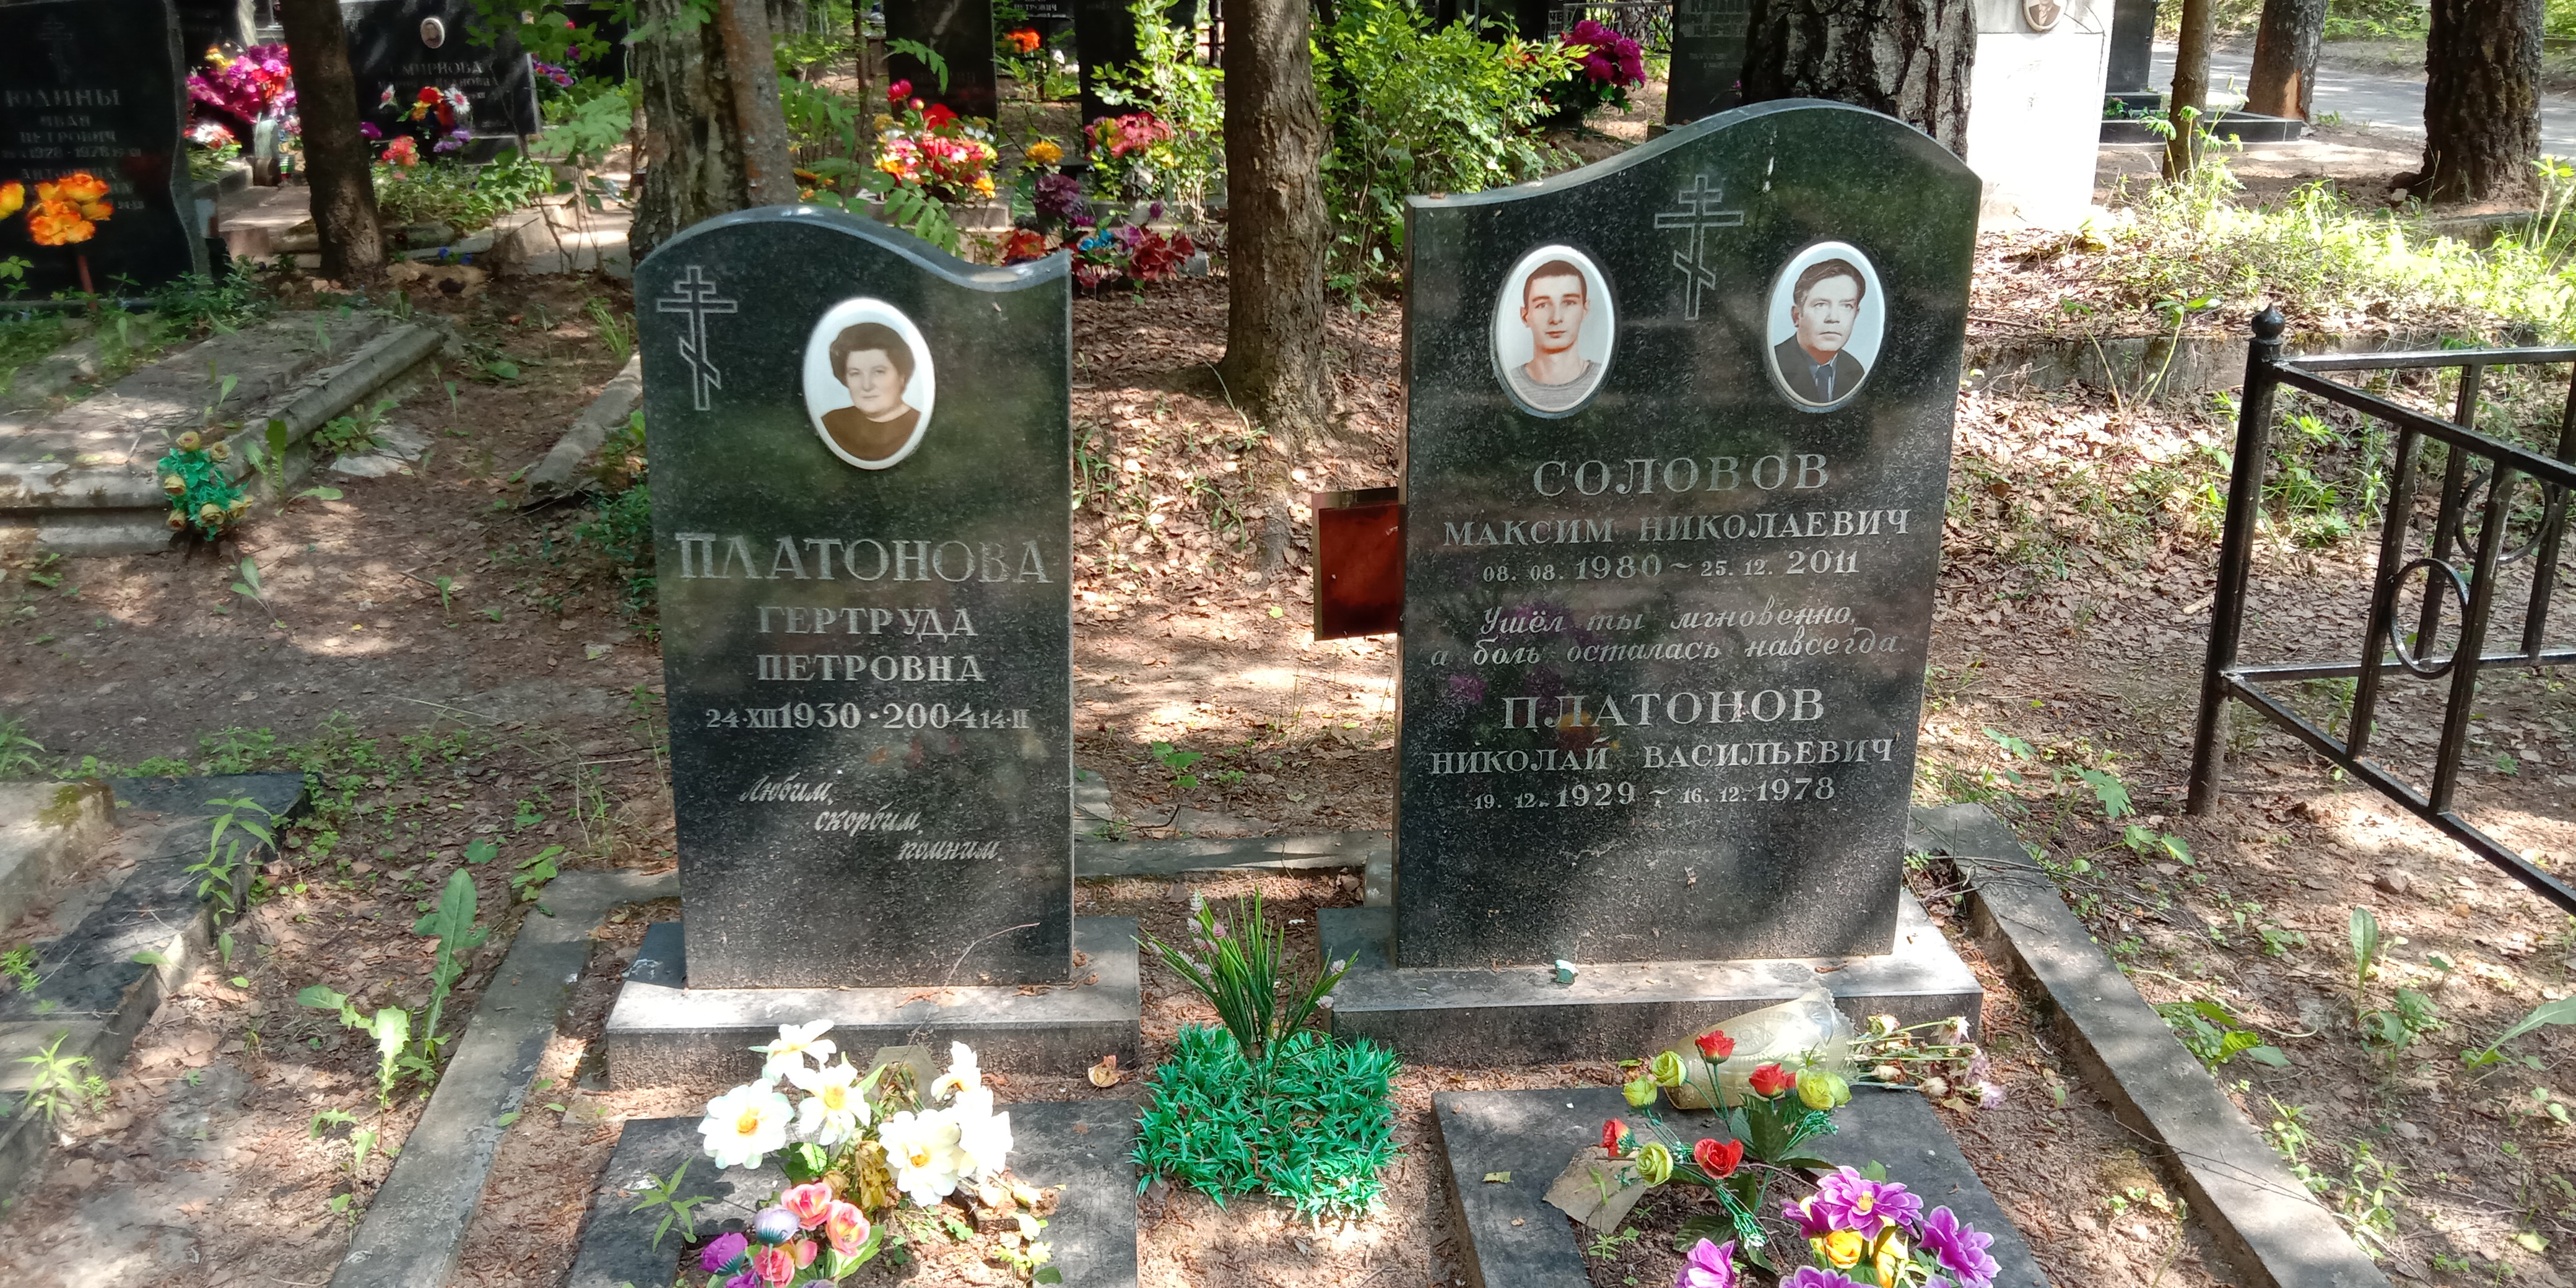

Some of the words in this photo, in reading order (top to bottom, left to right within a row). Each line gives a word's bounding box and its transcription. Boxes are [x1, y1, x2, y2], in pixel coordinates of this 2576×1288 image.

[4, 89, 121, 107] ЮДИНЫ
[1532, 453, 1829, 497] СОЛОВОВ
[1443, 518, 1612, 547] МАКСИМ
[1639, 509, 1911, 542] НИКОЛАЕВИЧ
[675, 533, 1053, 583] ПЛАТОНОВА
[1482, 565, 1516, 582] 08.
[1530, 564, 1564, 581] 08.
[1576, 554, 1662, 580] 1980
[1700, 560, 1733, 577] 25.
[1743, 559, 1773, 575] 12.
[1786, 549, 1860, 574] 2011
[757, 606, 978, 643] ГЕРТРУДА
[1479, 606, 1567, 635] Ушёл
[1586, 613, 1645, 632] ты
[1671, 594, 1856, 630] мгновенно,
[1430, 649, 1450, 666] а
[1473, 635, 1541, 666] боль
[1567, 640, 1722, 663] осталась
[1744, 625, 1905, 658] навсегда.
[757, 655, 986, 682] ПЕТРОВНА
[1500, 688, 1825, 729] ПЛАТОНОВ
[1430, 738, 1609, 775] НИКОЛАЙ
[1643, 738, 1893, 770] ВАСИЛЬЕВИЧ
[739, 772, 834, 806] Любим,
[1473, 793, 1502, 809] 19.
[1554, 781, 1635, 807] 1929
[1682, 787, 1710, 803] 16.
[1719, 786, 1747, 803] 12.
[1757, 777, 1835, 802] 1978
[814, 801, 923, 837] скорбим,
[897, 840, 1004, 862] помним.
